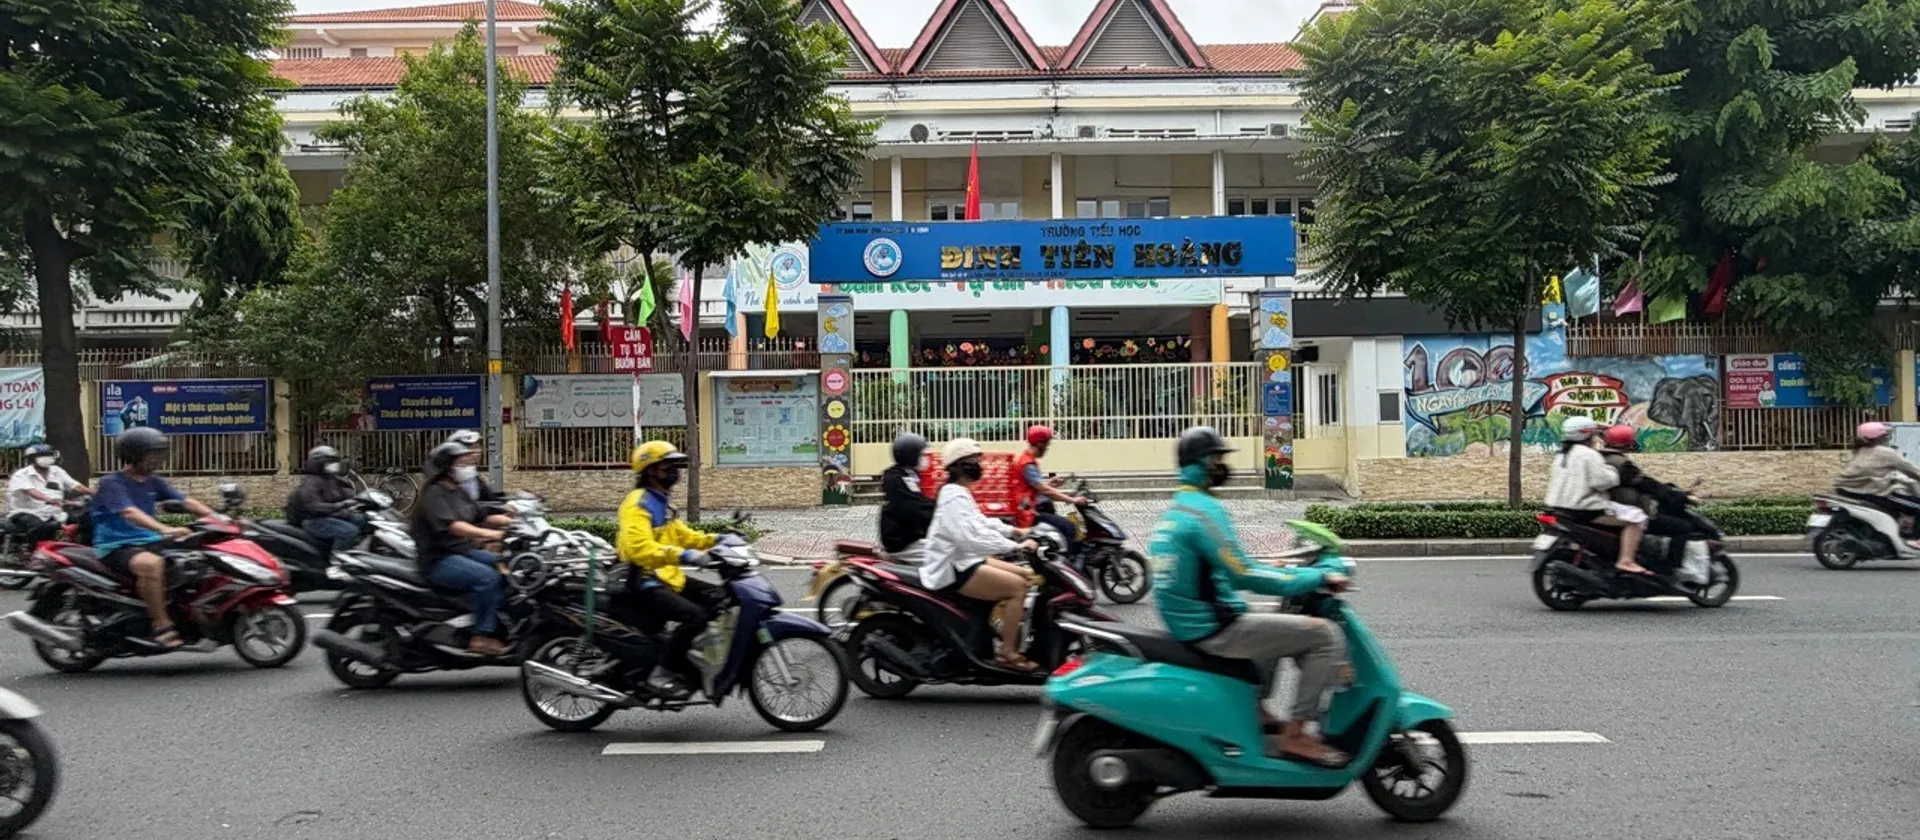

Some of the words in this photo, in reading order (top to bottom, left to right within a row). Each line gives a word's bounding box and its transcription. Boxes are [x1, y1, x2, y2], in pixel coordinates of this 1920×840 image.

[1119, 225, 1141, 239] HỌC
[1040, 239, 1116, 269] TIÊN
[1134, 237, 1243, 268] HOÀNG
[615, 355, 635, 369] BUÔN
[16, 398, 34, 409] LAI
